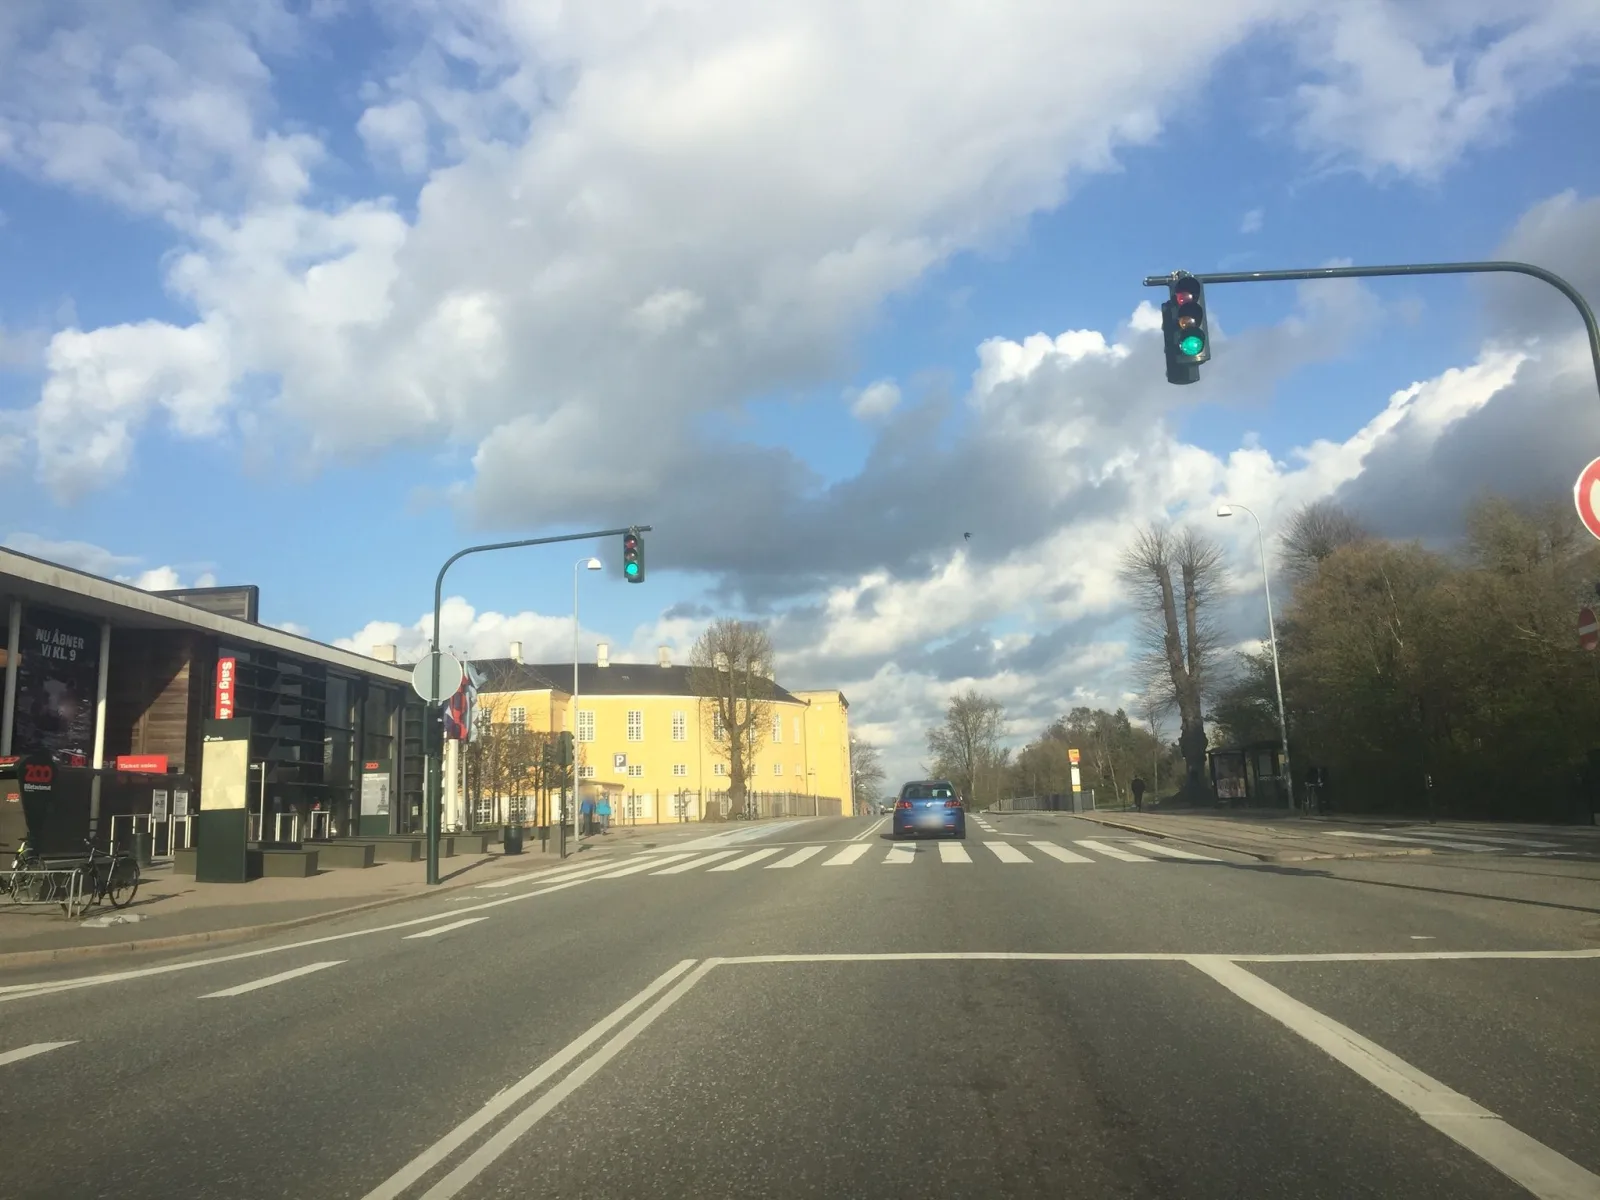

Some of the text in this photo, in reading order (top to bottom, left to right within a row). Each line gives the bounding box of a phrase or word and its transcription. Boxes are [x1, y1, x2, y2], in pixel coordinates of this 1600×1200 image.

[36, 629, 84, 649] NU ÅBNER
[42, 644, 51, 657] VI
[70, 650, 76, 661] 9
[219, 662, 232, 689] Salg
[221, 692, 231, 705] af
[616, 755, 625, 766] P
[25, 765, 52, 782] ZOO
